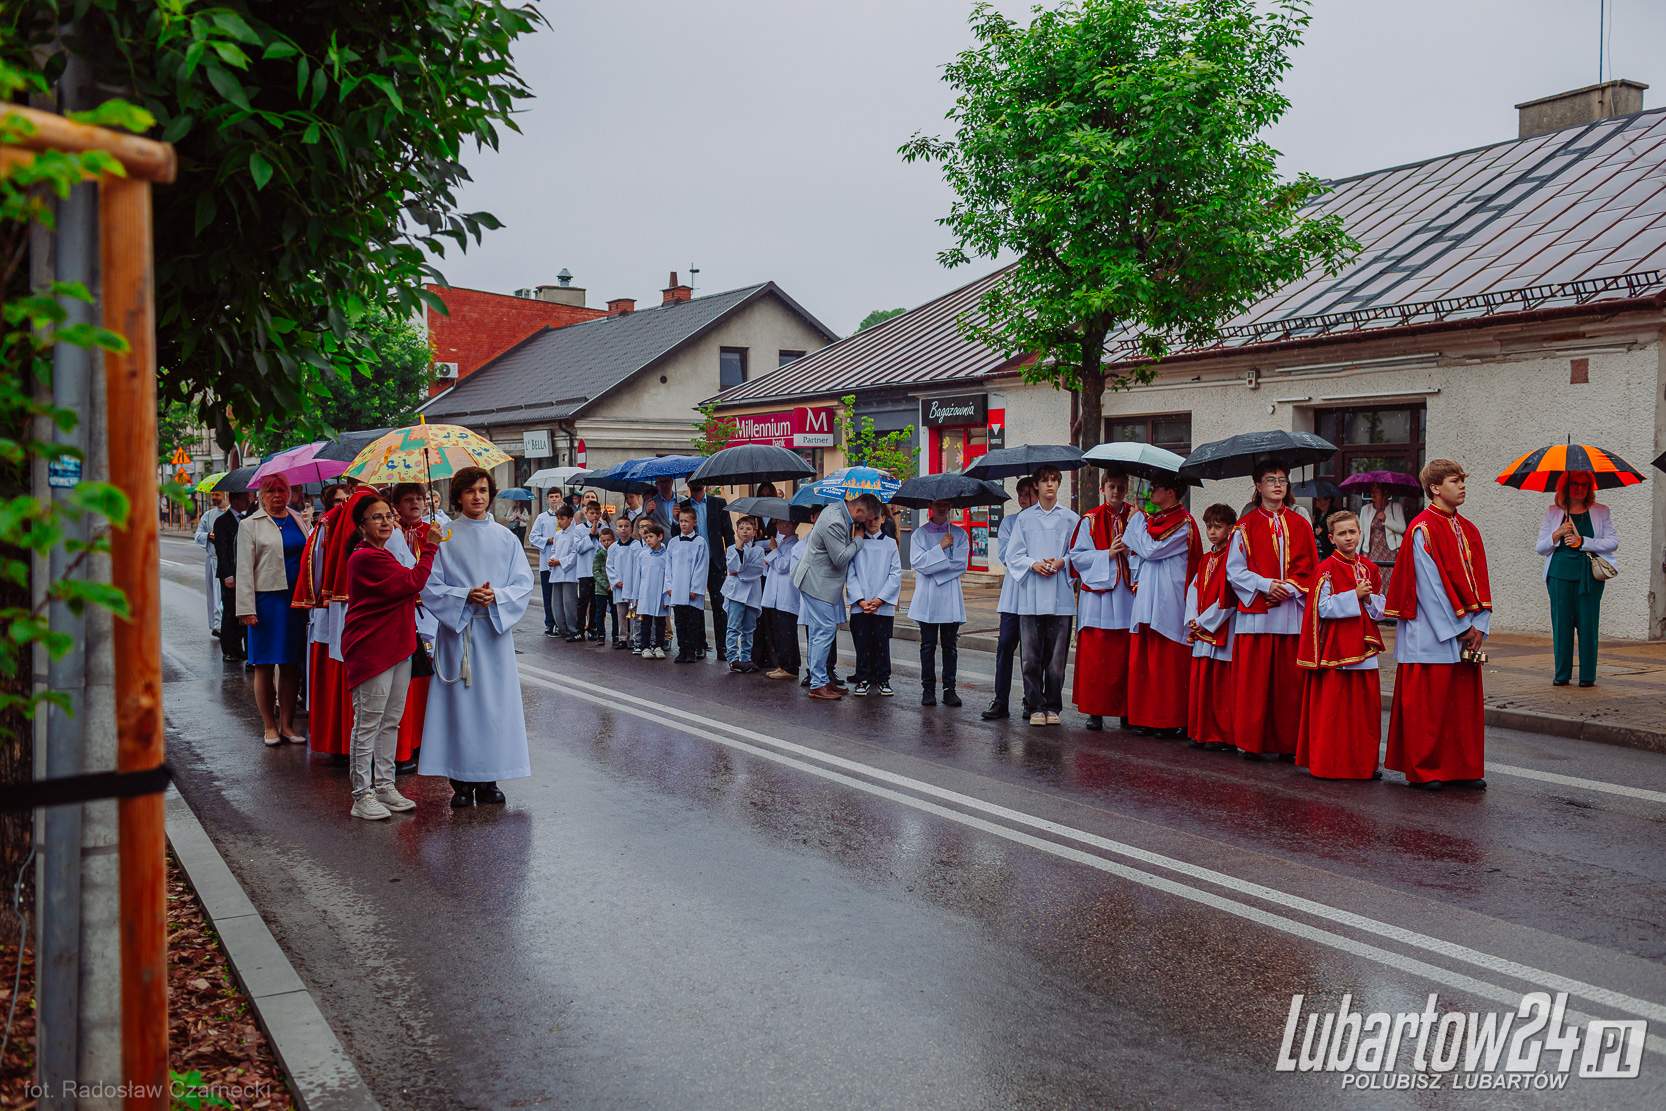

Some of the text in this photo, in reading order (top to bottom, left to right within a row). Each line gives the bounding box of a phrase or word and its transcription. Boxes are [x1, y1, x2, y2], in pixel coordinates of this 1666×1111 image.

[735, 417, 790, 438] Millennium
[806, 407, 828, 432] M
[772, 439, 786, 447] bank
